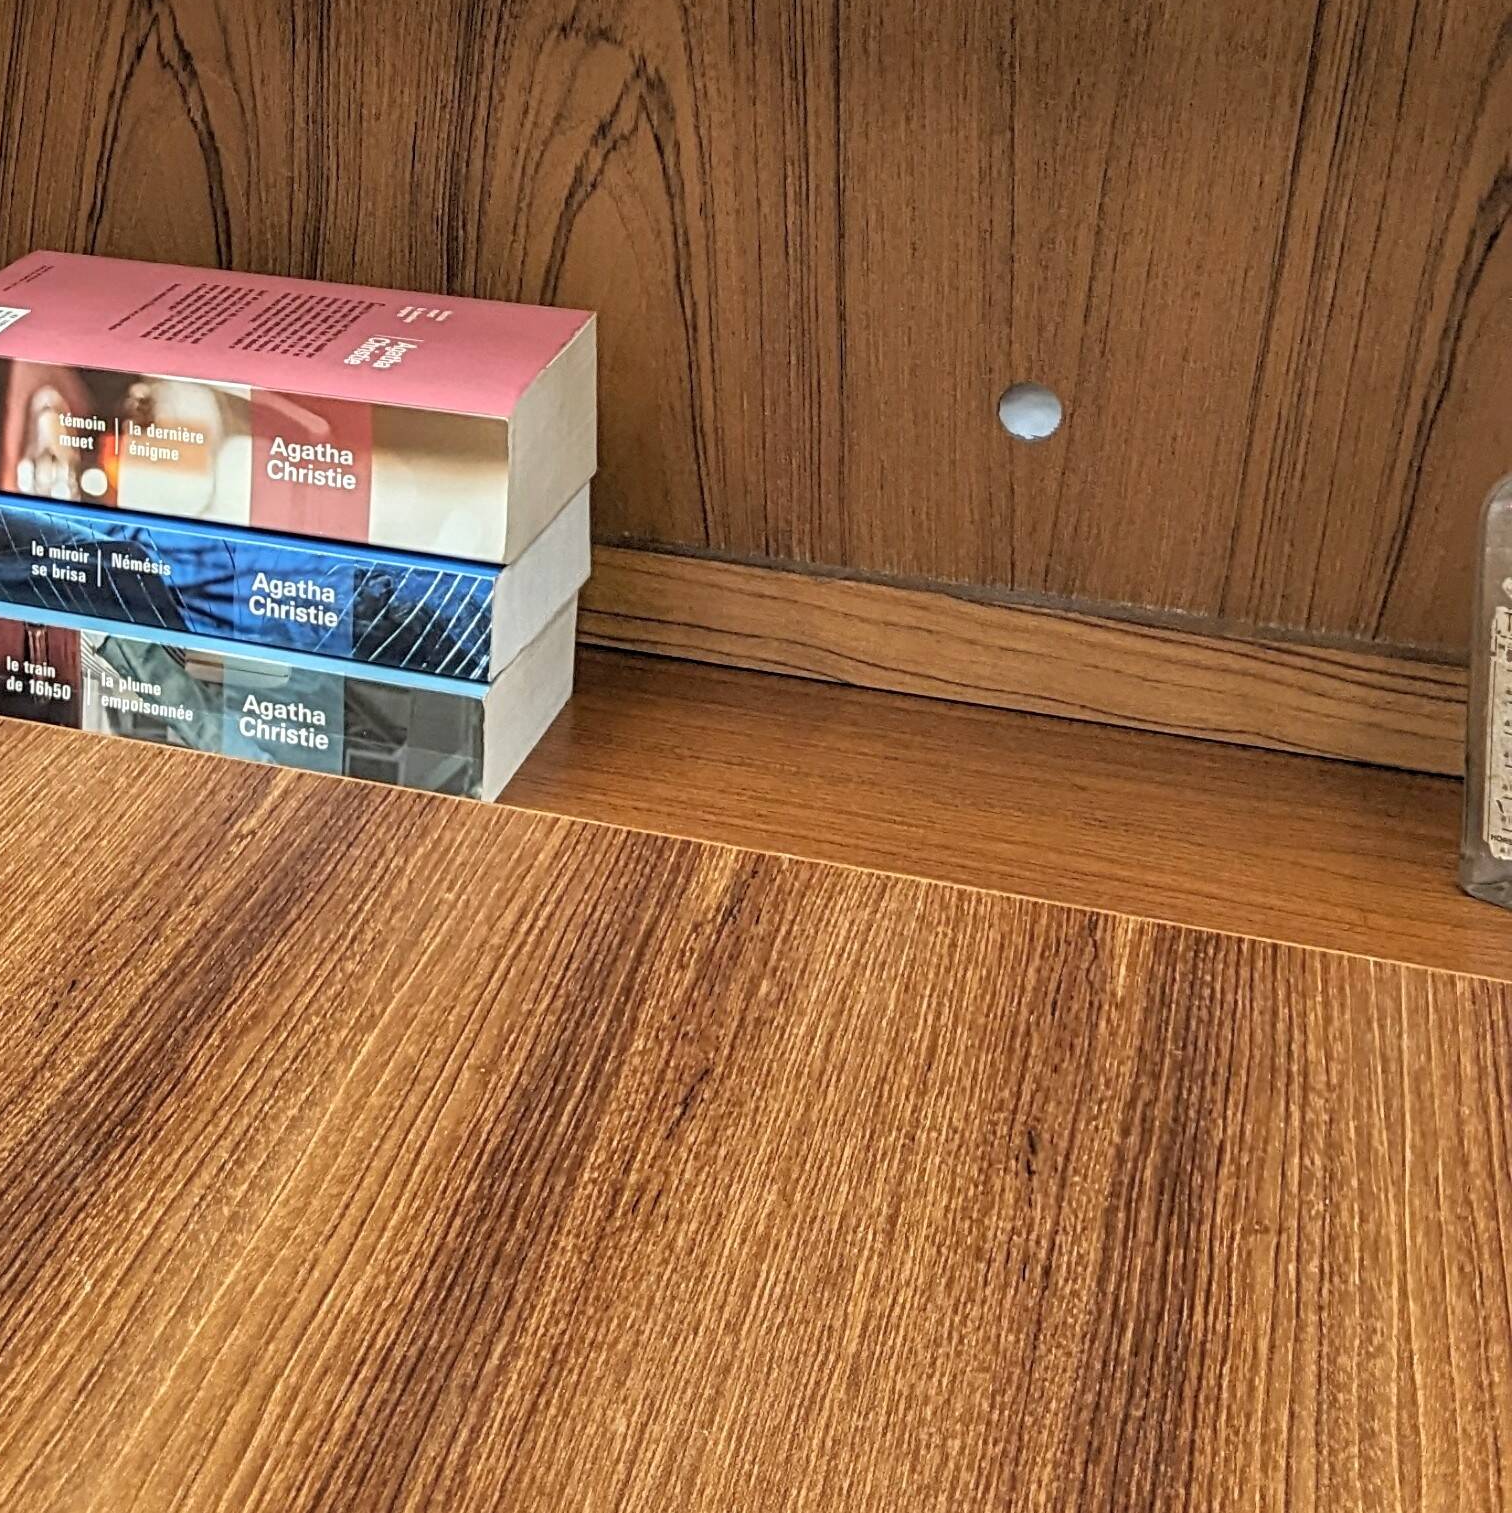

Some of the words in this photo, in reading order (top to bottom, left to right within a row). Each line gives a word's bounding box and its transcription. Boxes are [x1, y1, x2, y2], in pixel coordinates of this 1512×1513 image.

[59, 413, 107, 432] témoin
[128, 421, 142, 436] la
[146, 423, 205, 445] dernière
[59, 434, 95, 450] muet
[128, 440, 180, 462] énigme
[269, 436, 354, 466] Agatha
[266, 459, 357, 490] Christie
[31, 540, 45, 557] le
[48, 544, 90, 564] miroir
[111, 552, 172, 576] Némésis
[31, 564, 48, 577] se
[52, 563, 87, 584] brisa
[251, 572, 336, 604] Agatha
[248, 595, 338, 628] Christie
[6, 656, 20, 672] le
[23, 660, 56, 679] train
[6, 676, 24, 692] de
[29, 679, 72, 701] 16h50
[100, 672, 114, 689] la
[118, 676, 162, 697] plume
[100, 694, 195, 722] empoisonnée
[242, 694, 326, 727] Agatha
[239, 716, 329, 750] Christie
